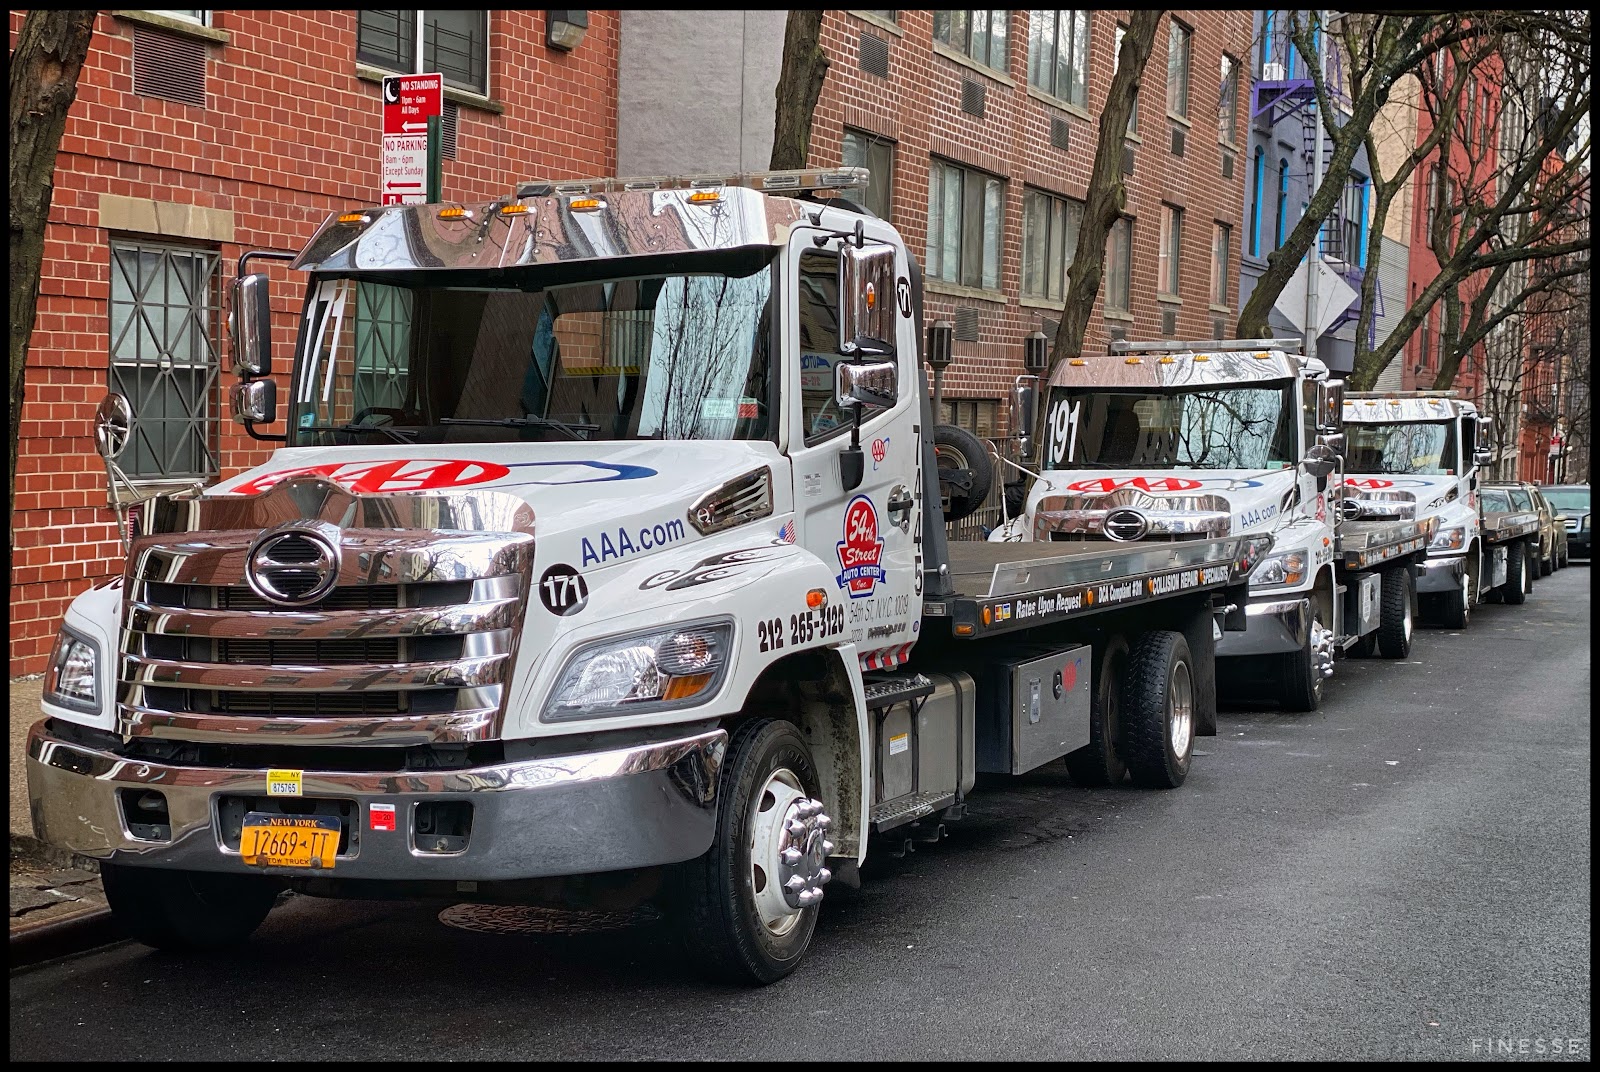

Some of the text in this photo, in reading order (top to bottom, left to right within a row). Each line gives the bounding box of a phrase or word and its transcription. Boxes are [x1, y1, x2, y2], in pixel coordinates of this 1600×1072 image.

[401, 79, 439, 91] NO STANDING
[415, 95, 426, 104] 6am
[401, 105, 419, 115] All Days
[385, 140, 427, 151] NO PARKING
[385, 155, 398, 164] 8am
[401, 155, 414, 165] 6pm
[385, 166, 424, 177] Except Sunday
[297, 279, 349, 403] 171
[1048, 399, 1081, 464] 191
[1241, 504, 1277, 529] AAAcom
[580, 517, 685, 568] AAA.com
[845, 547, 877, 565] Street
[843, 566, 880, 580] AUTO CENTER
[1152, 565, 1229, 595] COLLISION REPAIR SPECIALISTS
[543, 575, 583, 607] 171
[1098, 584, 1109, 603] DCA
[1109, 581, 1131, 602] Complaint
[1016, 592, 1082, 619] Rates Upon Request
[758, 617, 784, 653] 212
[790, 603, 844, 645] 265-3120
[290, 771, 301, 779] NY
[272, 783, 296, 793] 875765
[270, 817, 318, 828] NEW YORK
[253, 829, 329, 858] 12669 TT
[285, 858, 309, 866] TRUCK
